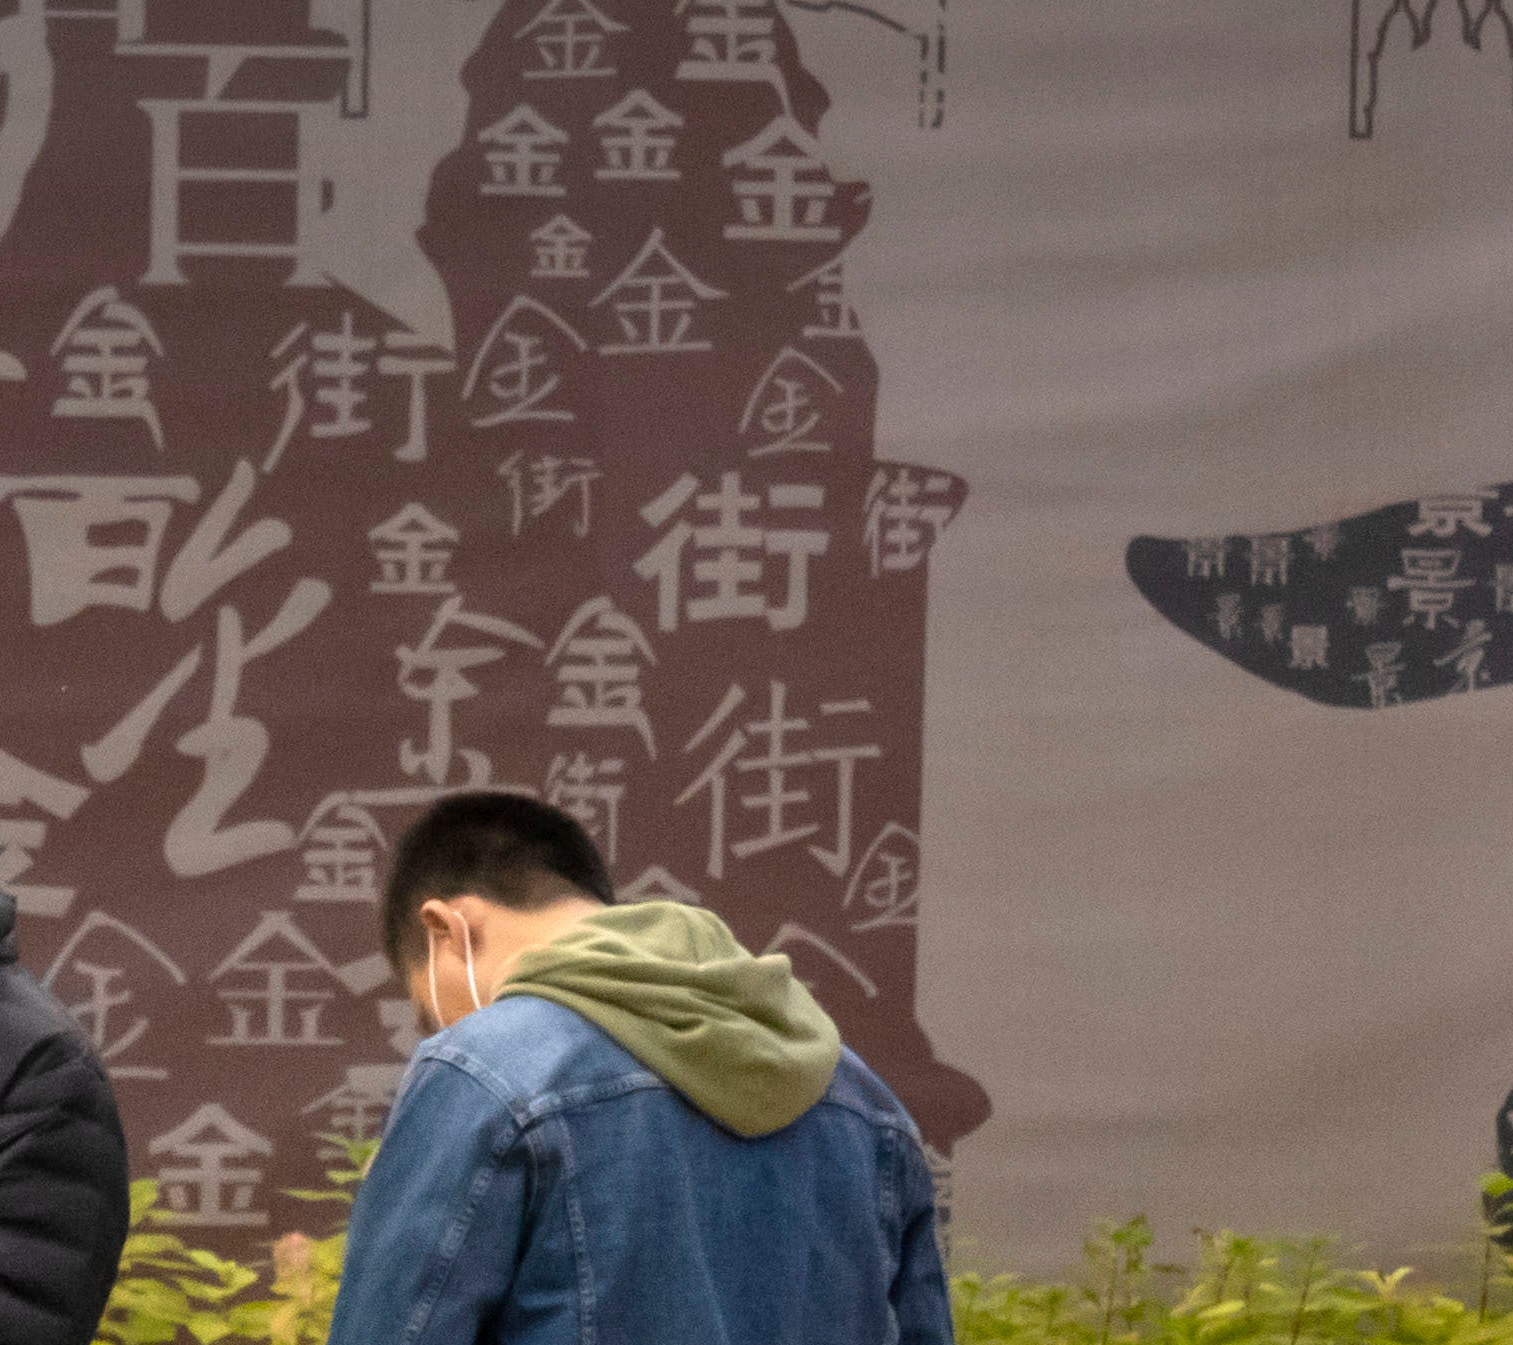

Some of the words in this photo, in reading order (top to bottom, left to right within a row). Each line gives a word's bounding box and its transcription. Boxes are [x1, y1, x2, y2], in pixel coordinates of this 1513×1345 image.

[513, 0, 630, 80] 金
[477, 103, 570, 197] 金
[591, 88, 684, 181] 金
[722, 117, 844, 241] 金
[529, 213, 592, 279] 金
[590, 227, 729, 356] 金
[50, 285, 166, 451] 金
[269, 312, 457, 473] 街
[462, 295, 589, 428] 金
[738, 346, 846, 458] 金
[368, 502, 460, 596] 金
[634, 470, 831, 632] 街
[1387, 546, 1477, 630] 景
[545, 597, 659, 762] 金
[676, 682, 883, 881] 街
[208, 910, 350, 1048] 金
[147, 1102, 275, 1227] 金
